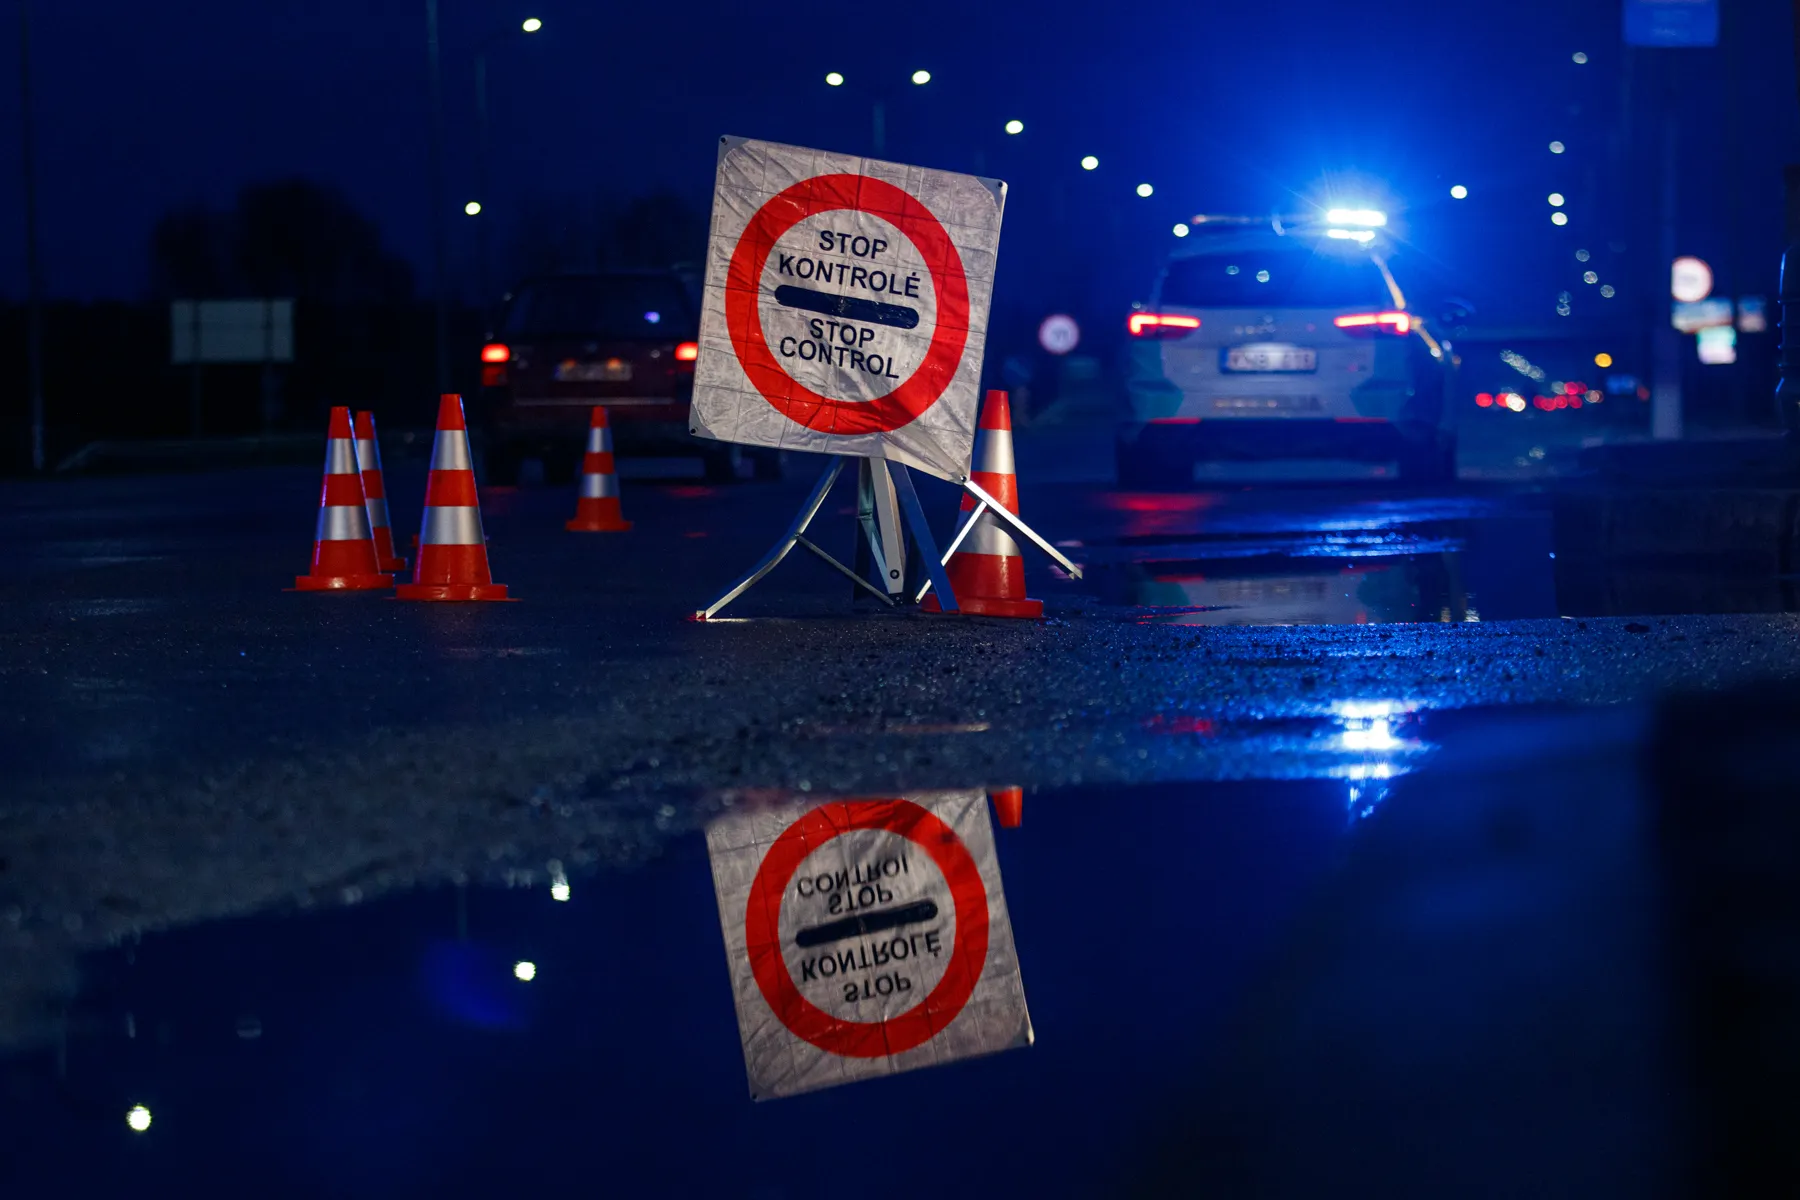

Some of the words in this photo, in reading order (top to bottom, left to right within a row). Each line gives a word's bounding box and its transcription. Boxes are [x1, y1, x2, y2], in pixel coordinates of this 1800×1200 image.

[819, 230, 888, 259] STOP
[779, 253, 921, 299] KONTROLĖ
[809, 318, 875, 348] STOP
[780, 336, 899, 379] CONTROL
